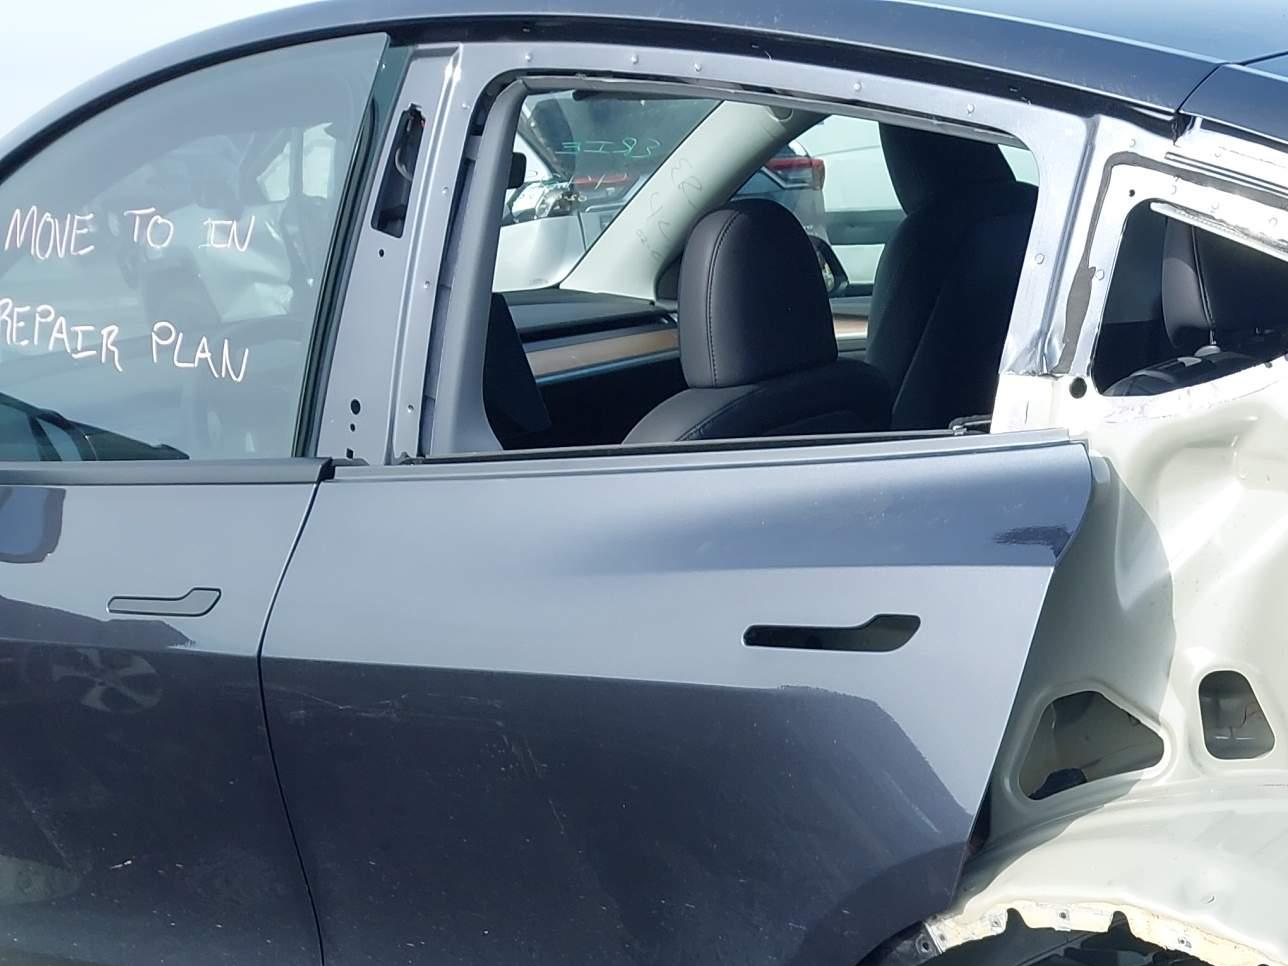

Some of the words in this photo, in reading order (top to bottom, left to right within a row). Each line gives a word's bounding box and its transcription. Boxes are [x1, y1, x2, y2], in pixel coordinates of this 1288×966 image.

[5, 205, 95, 260] MOVE
[123, 207, 174, 248] TO
[199, 215, 256, 252] IN
[0, 298, 123, 372] REPAIR
[152, 321, 249, 382] PLAN
